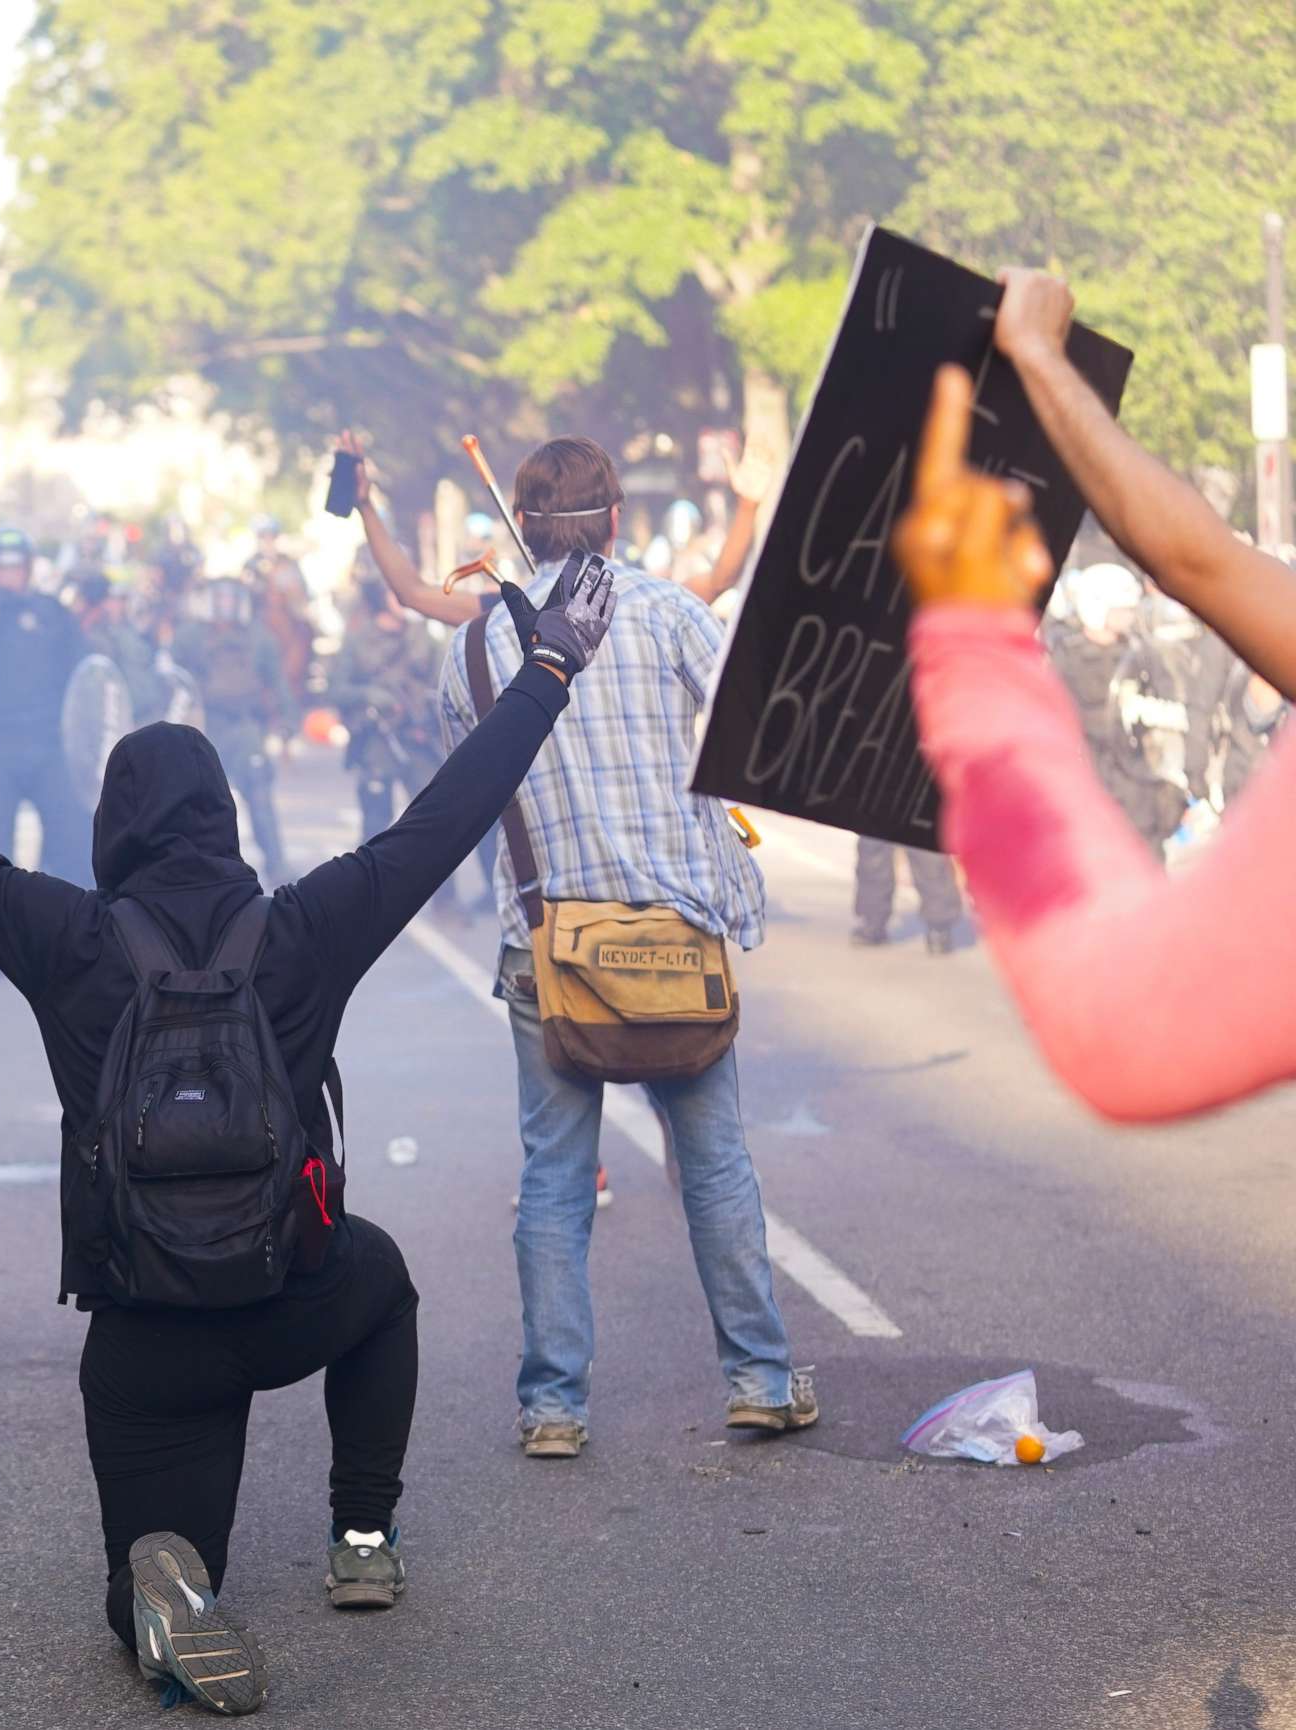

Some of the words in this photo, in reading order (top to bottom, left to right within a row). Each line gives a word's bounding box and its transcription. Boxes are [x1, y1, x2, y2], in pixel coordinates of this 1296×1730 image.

[799, 435, 1049, 614] CA'
[744, 614, 935, 829] BREA
[601, 950, 699, 967] KEYDET-LIFE
